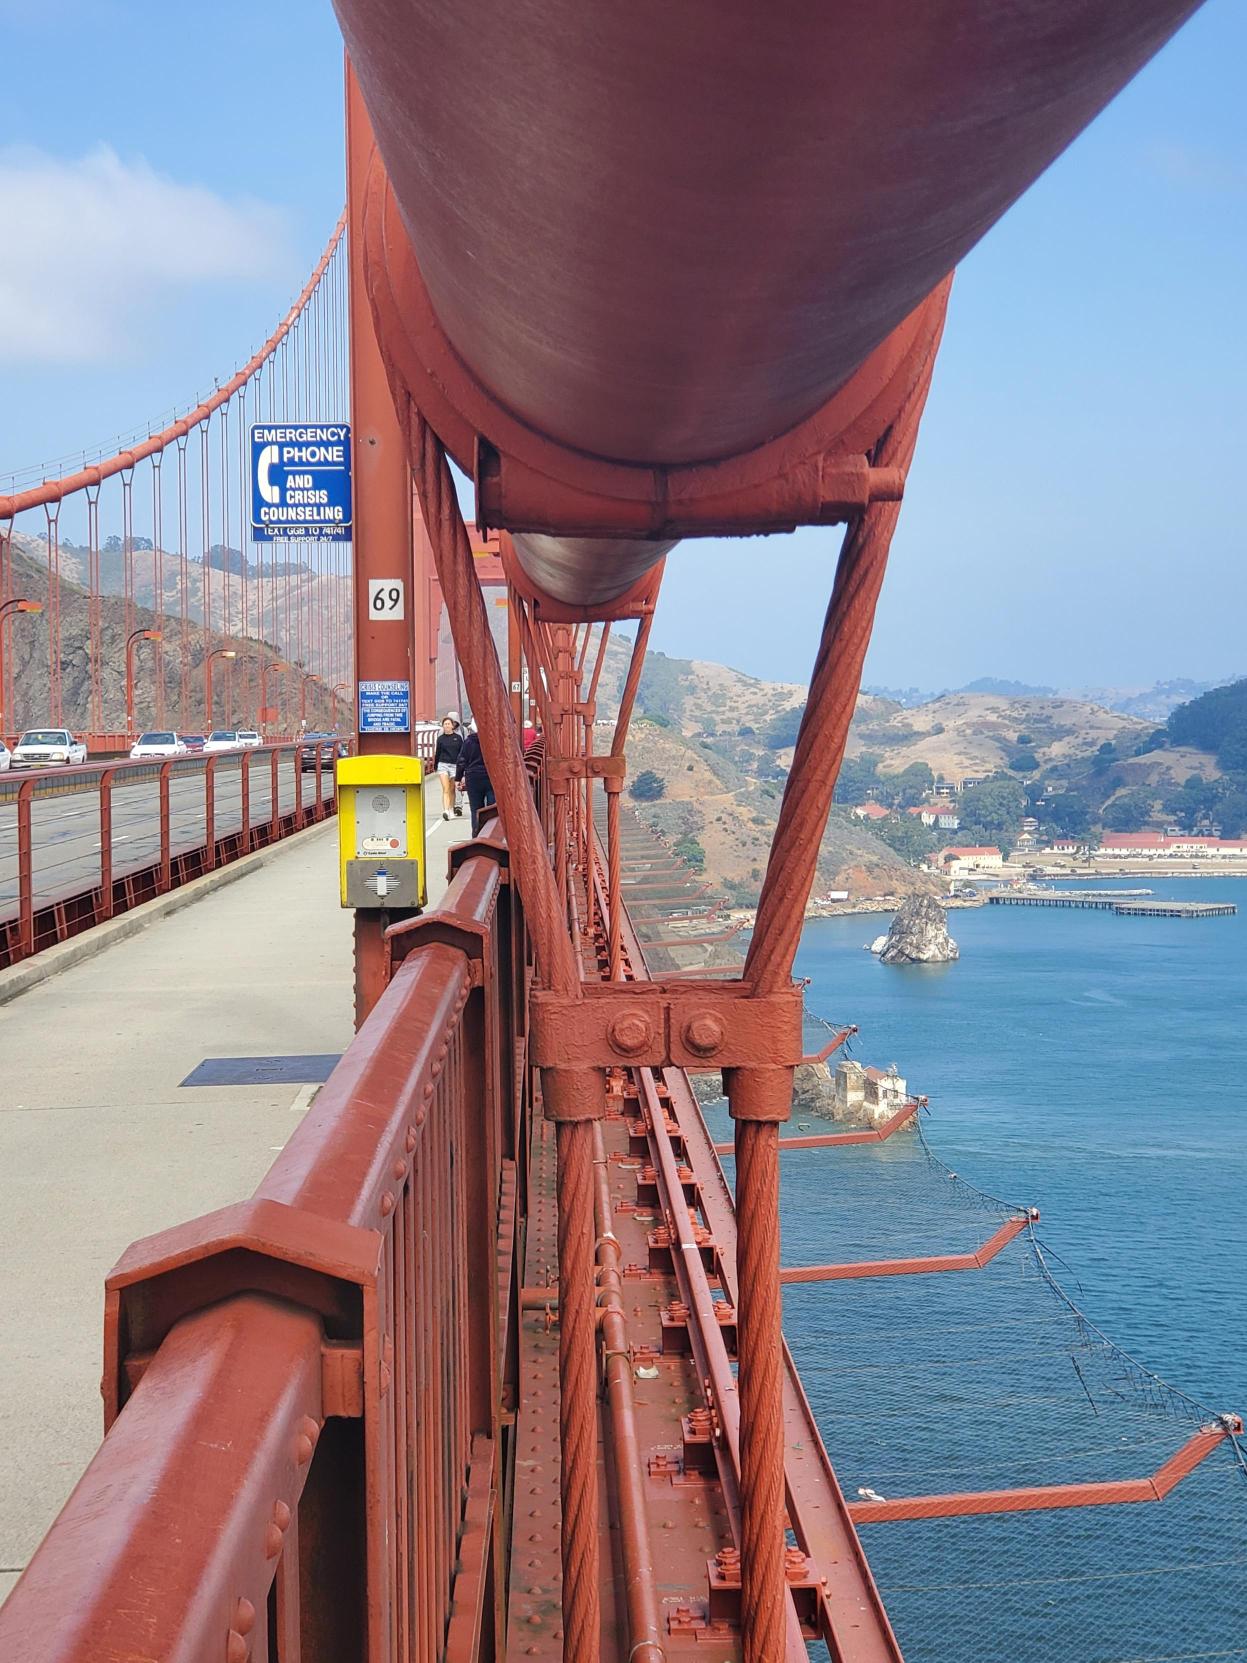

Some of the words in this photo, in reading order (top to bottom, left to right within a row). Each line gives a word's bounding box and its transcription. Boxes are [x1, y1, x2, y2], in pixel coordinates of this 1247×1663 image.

[254, 428, 347, 442] EMERGENCY
[283, 446, 344, 462] PHONE
[286, 475, 313, 488] AND
[286, 490, 328, 504] CRISIS
[260, 506, 343, 520] COUNSELING
[264, 527, 283, 535] TEXT
[287, 527, 305, 535] GGB
[308, 527, 319, 535] TO
[322, 527, 345, 535] 741741
[373, 588, 400, 611] 69
